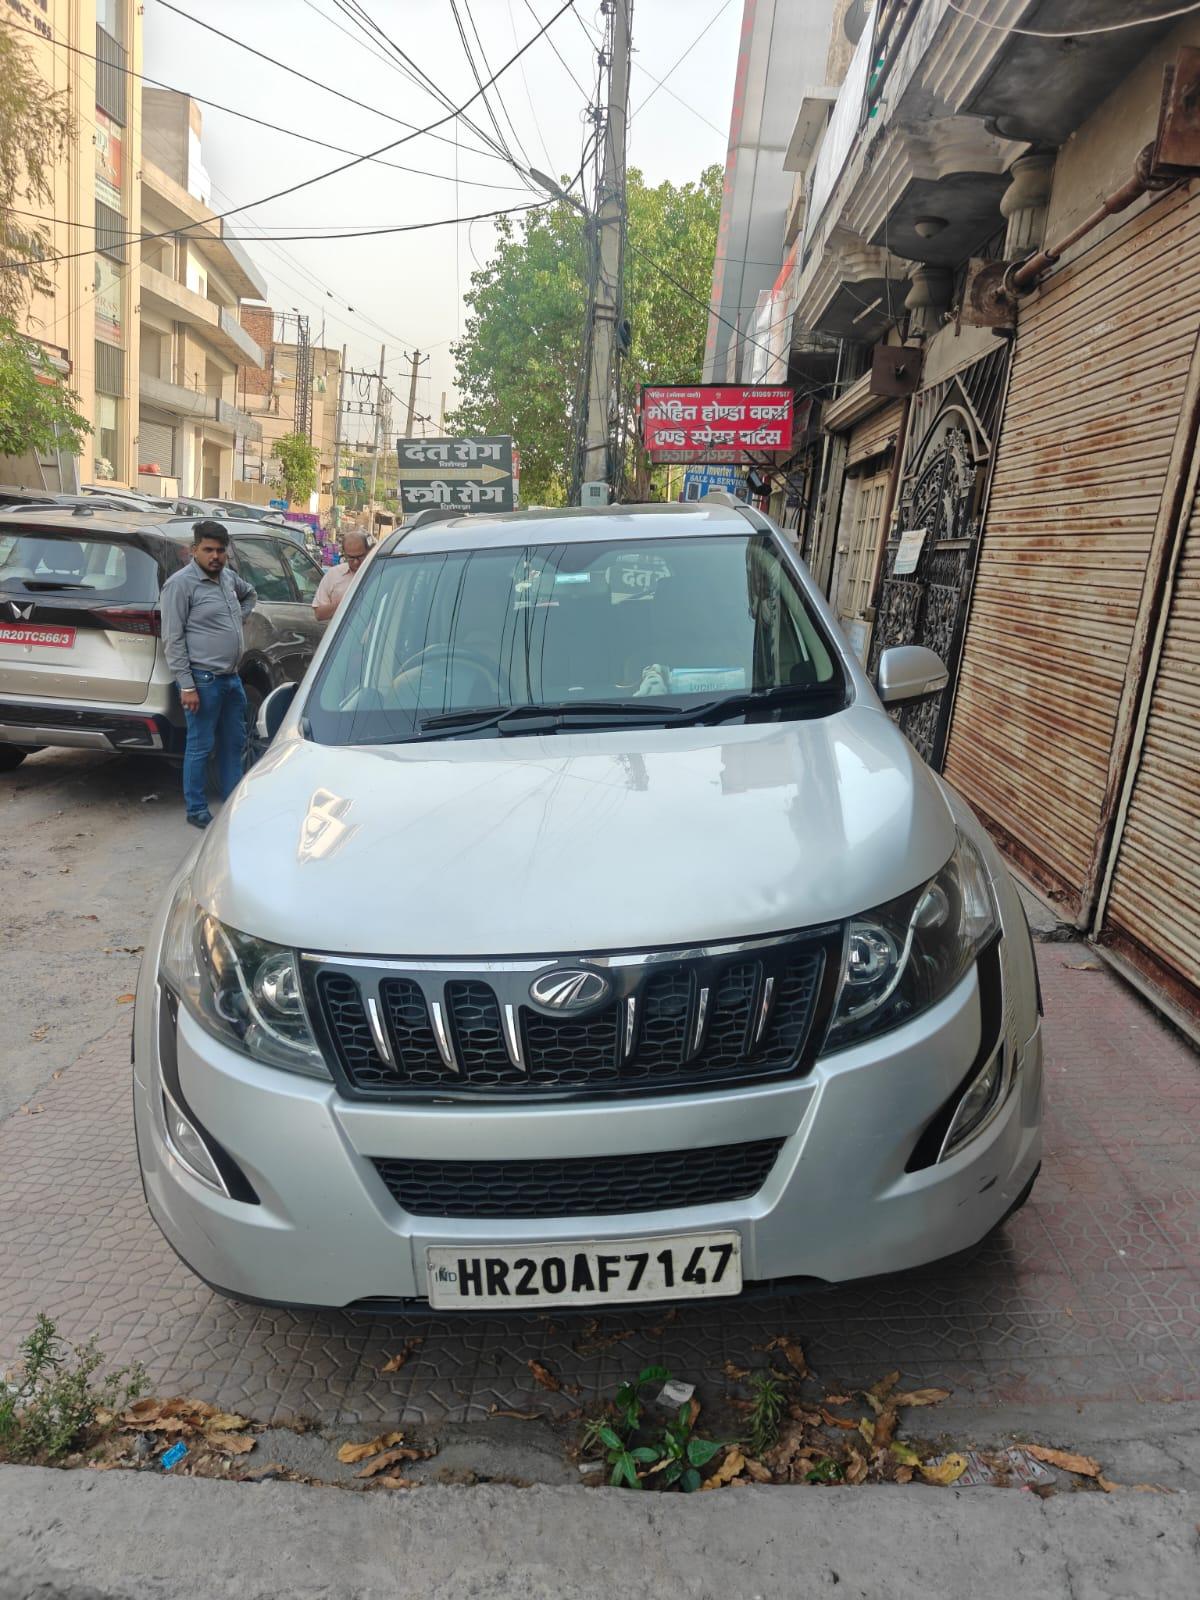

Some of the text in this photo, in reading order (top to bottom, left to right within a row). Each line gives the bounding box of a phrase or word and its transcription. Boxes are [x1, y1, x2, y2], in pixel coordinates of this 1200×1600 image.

[648, 400, 698, 421] मोहित
[701, 401, 746, 421] होण्डा
[654, 430, 687, 445] एण्ड
[403, 438, 503, 462] दंत रोग
[690, 474, 708, 483] SALE
[403, 480, 505, 503] स्त्री रोग
[457, 1243, 733, 1296] HR20AF7147
